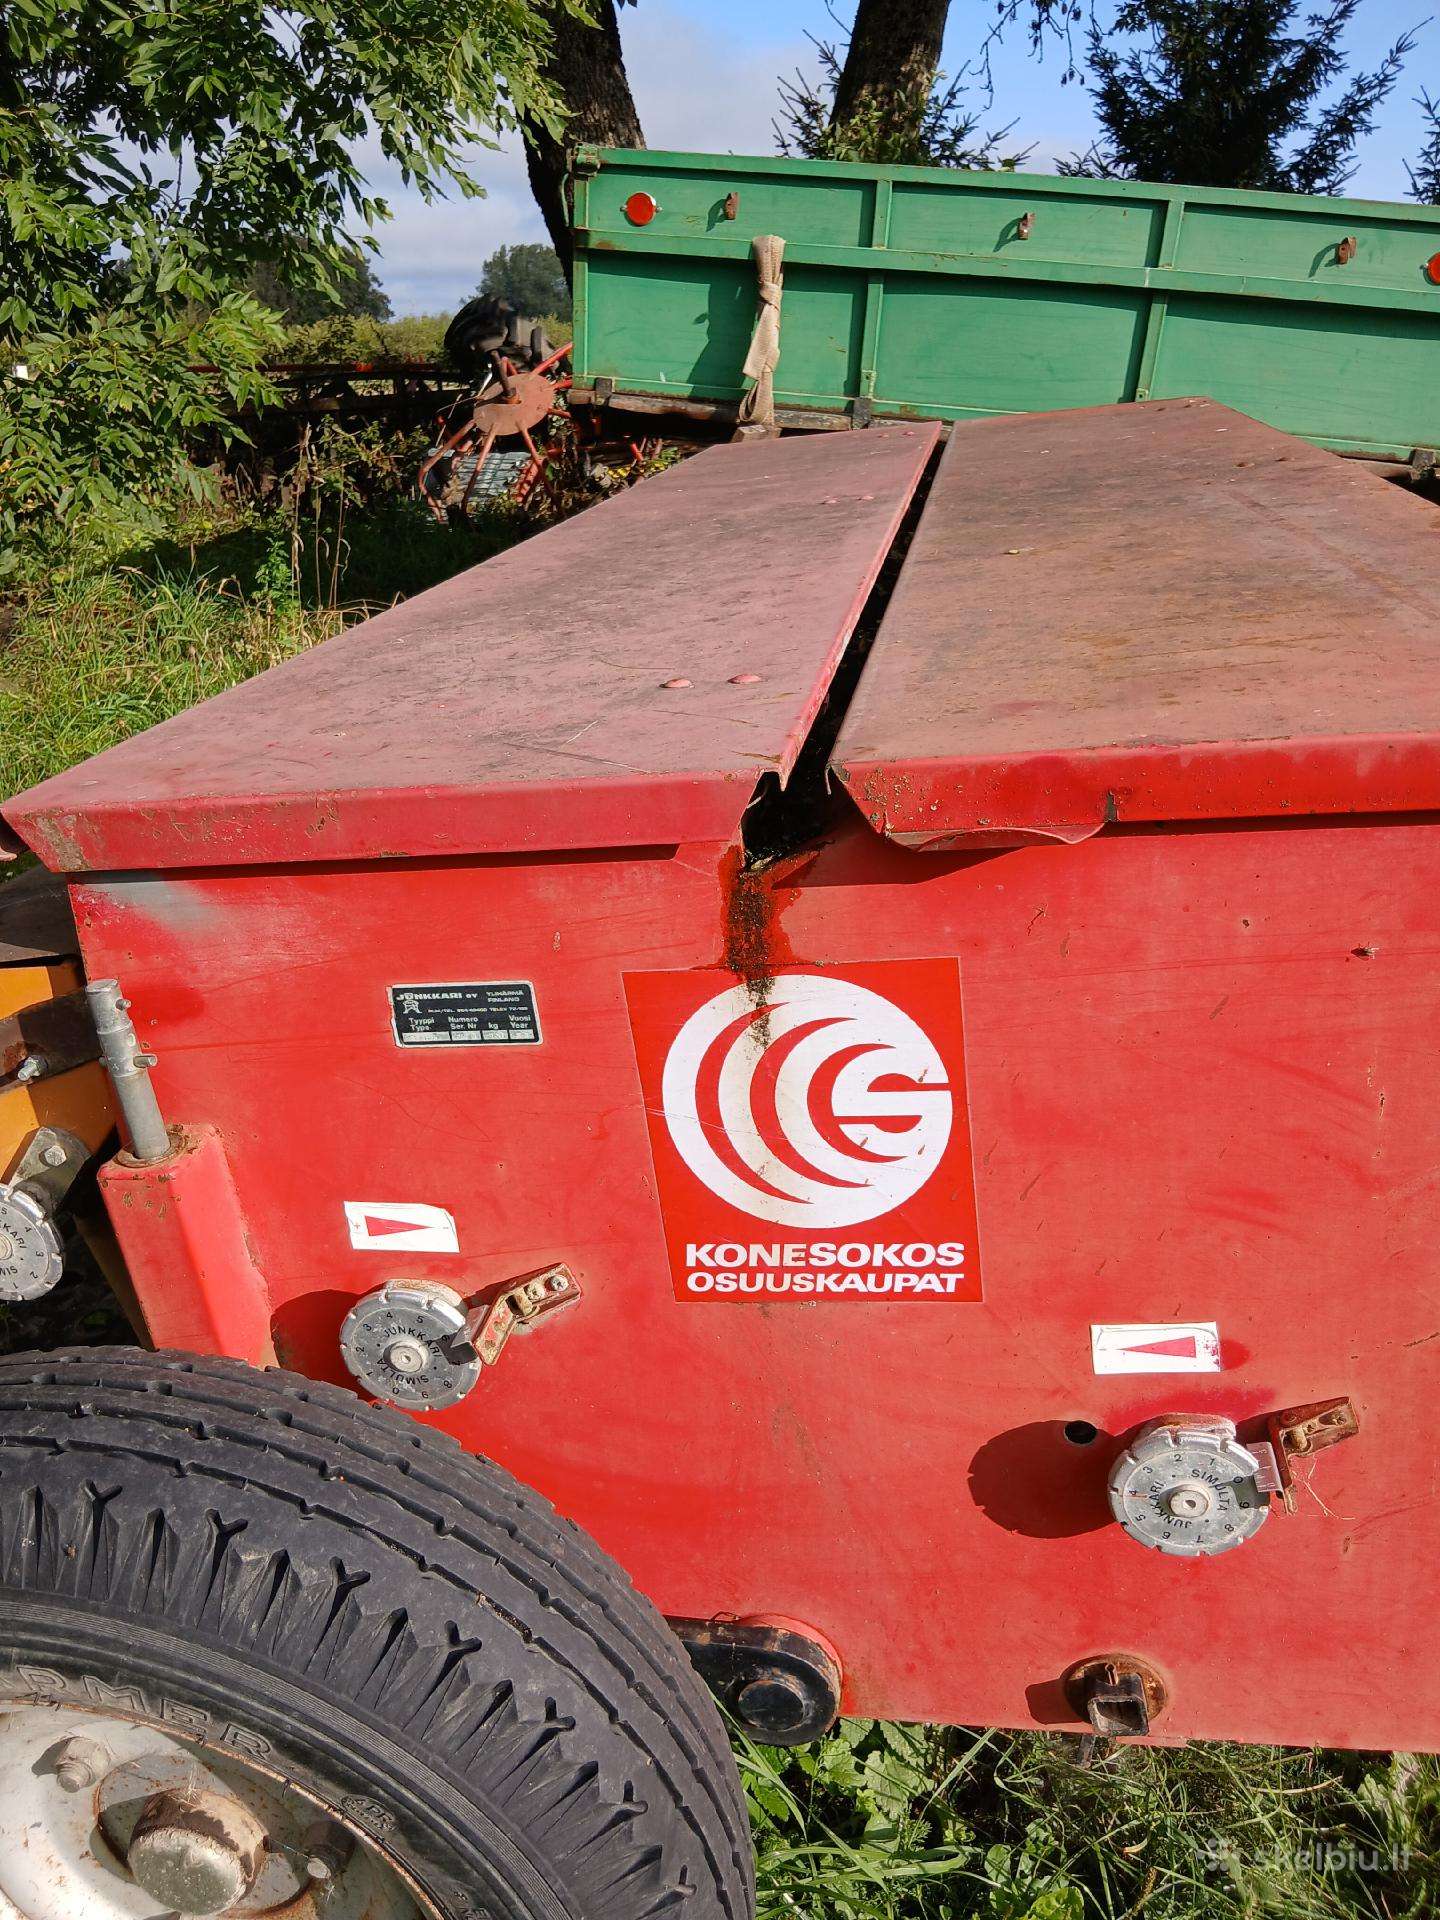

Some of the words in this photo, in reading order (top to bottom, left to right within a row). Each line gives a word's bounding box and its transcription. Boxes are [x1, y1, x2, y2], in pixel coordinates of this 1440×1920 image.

[408, 1016, 435, 1025] Tyyppi
[447, 1015, 479, 1023] Numero
[508, 1014, 531, 1022] Vuosi
[488, 1021, 499, 1030] kg
[510, 1020, 529, 1029] Year
[685, 1242, 965, 1268] KONESOKOS
[686, 1271, 964, 1293] OSUUSKAUPAT
[383, 1326, 442, 1358] JUNKKARI
[362, 1323, 372, 1332] 3
[385, 1311, 394, 1320] 4
[416, 1314, 425, 1324] 5
[443, 1379, 453, 1389] 8
[376, 1357, 430, 1386] SIMULTA
[1173, 1453, 1183, 1463] 2
[1142, 1465, 1154, 1475] 3
[1190, 1469, 1232, 1512] SIMULTA
[1148, 1480, 1194, 1530] JUNKKARI
[1135, 1513, 1147, 1523] 5
[1223, 1522, 1235, 1533] 8
[1196, 1534, 1205, 1544] 7
